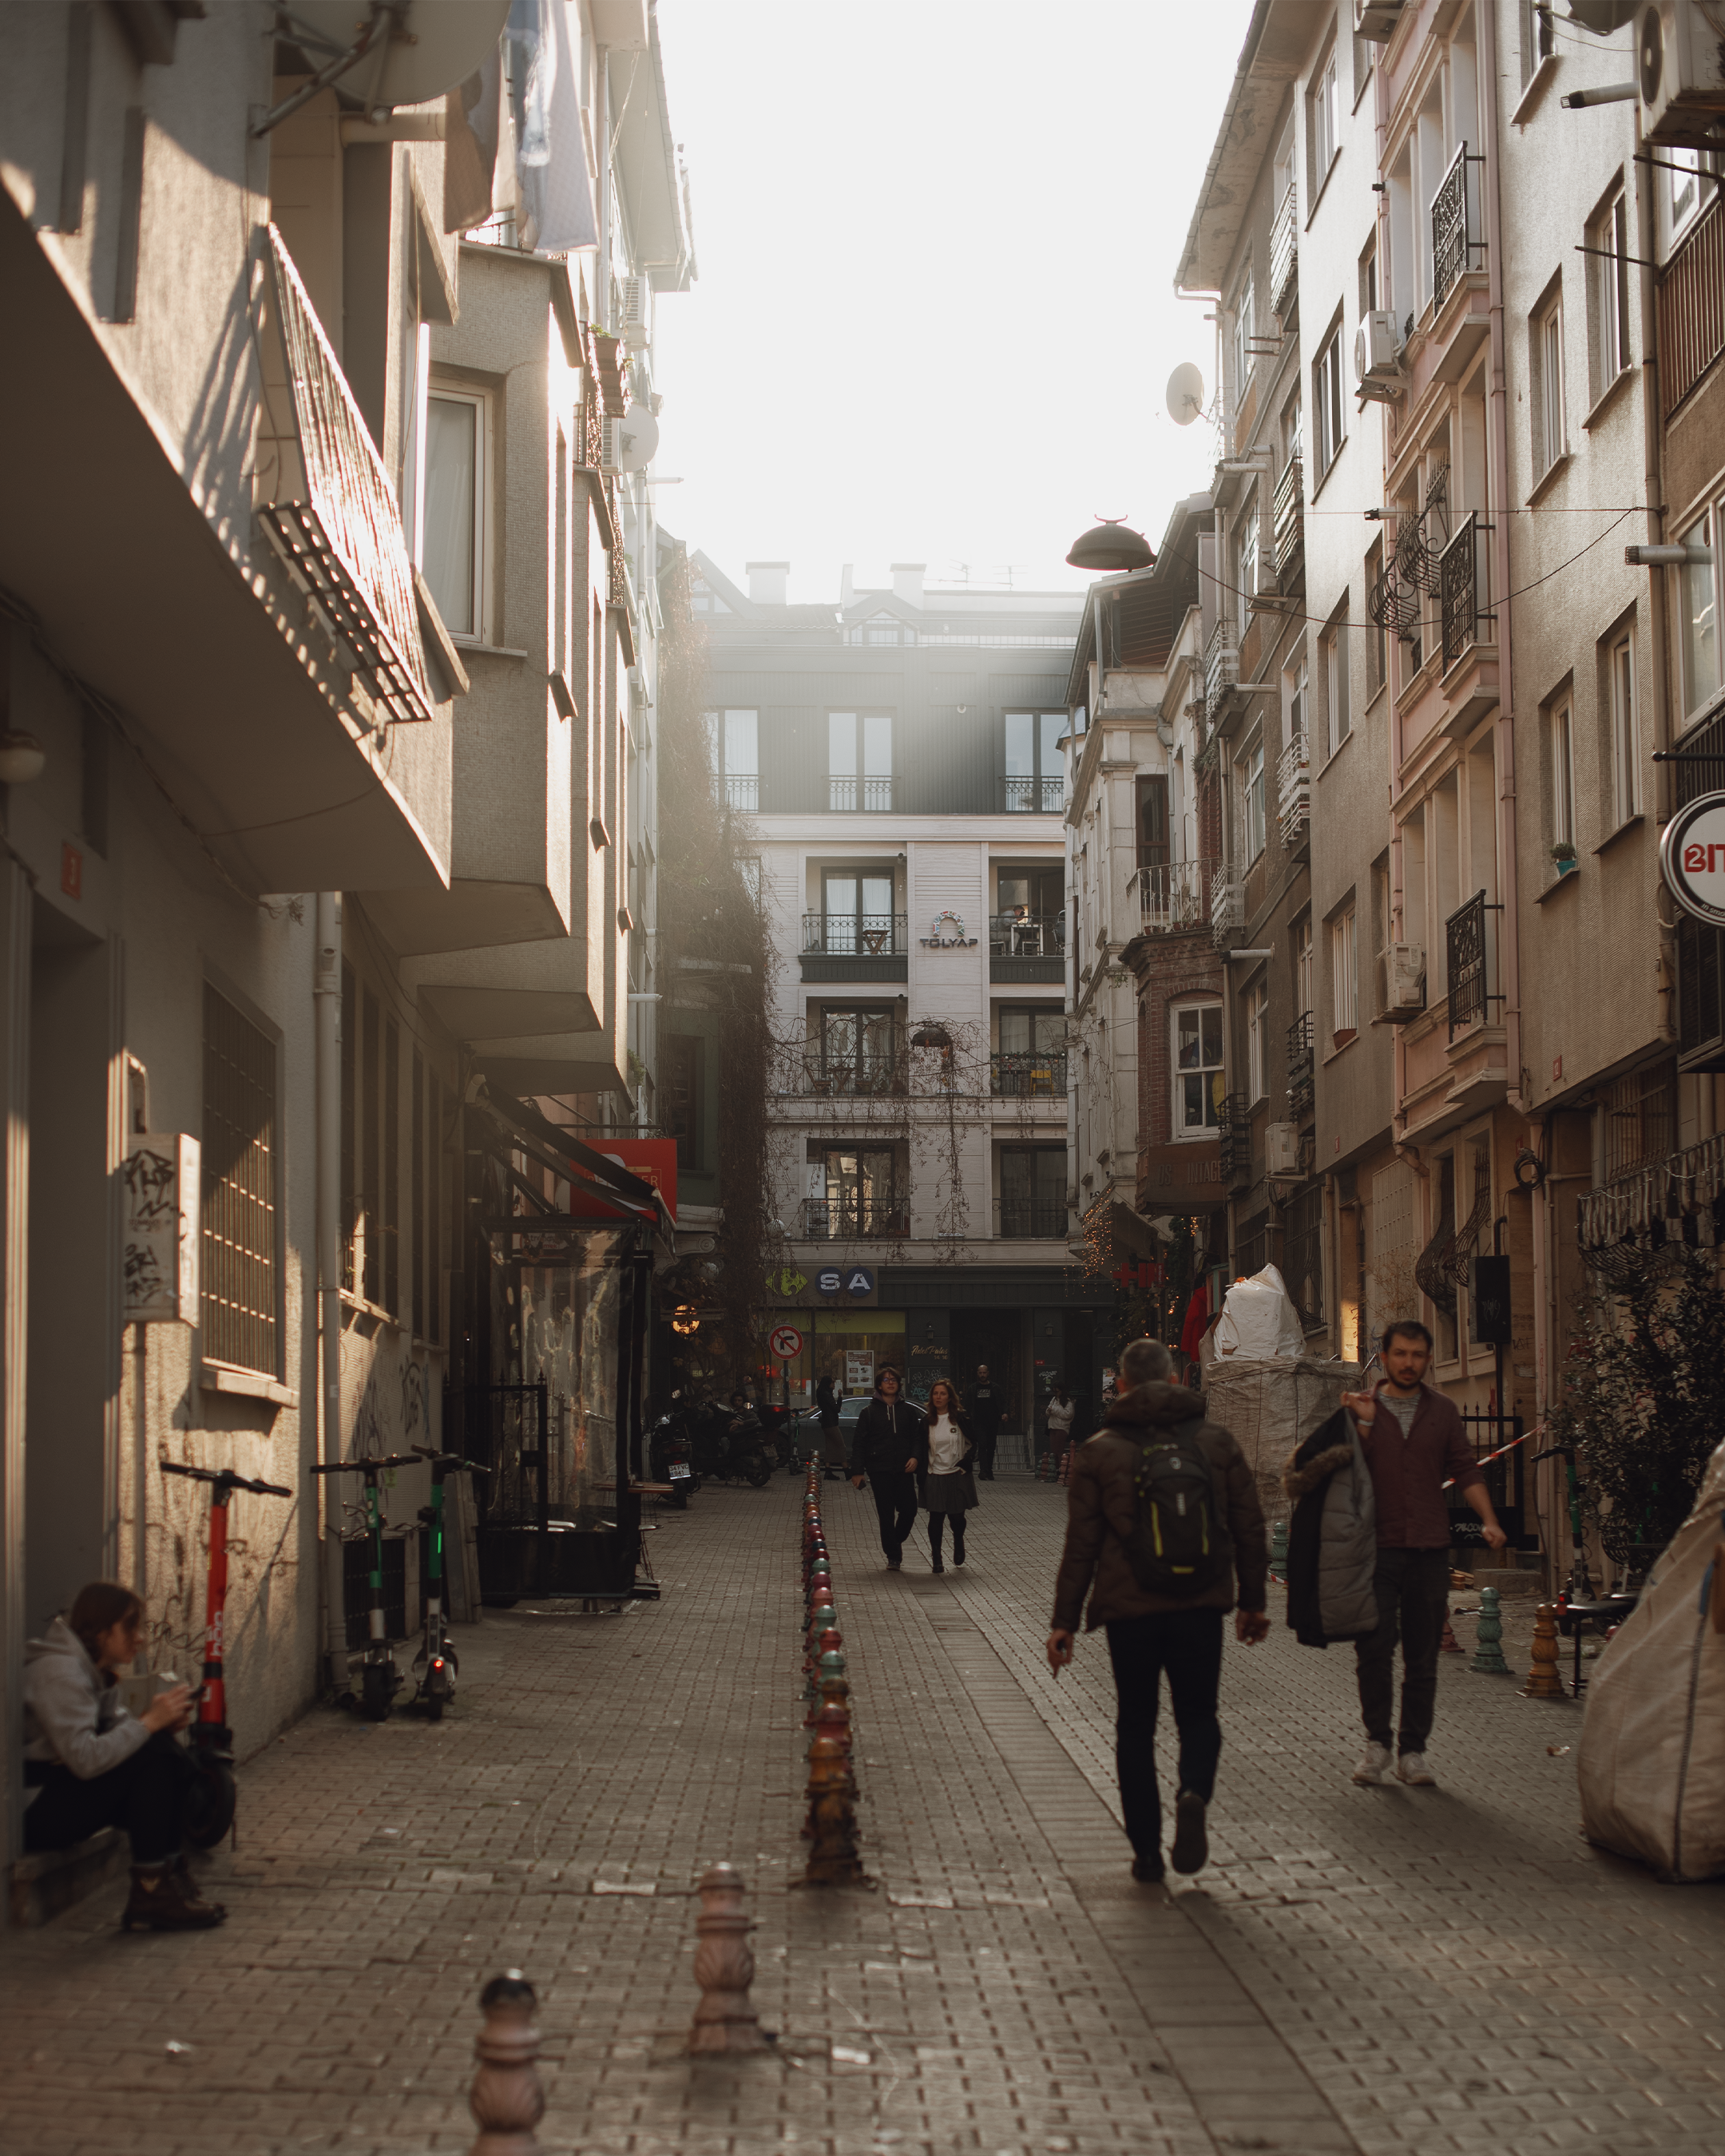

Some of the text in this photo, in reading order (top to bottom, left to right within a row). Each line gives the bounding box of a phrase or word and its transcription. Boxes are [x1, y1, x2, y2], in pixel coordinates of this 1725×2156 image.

[919, 937, 978, 948] TOLYAP
[1158, 1164, 1172, 1186] OS
[819, 1273, 871, 1290] SA
[910, 1345, 949, 1356] Adel Palas
